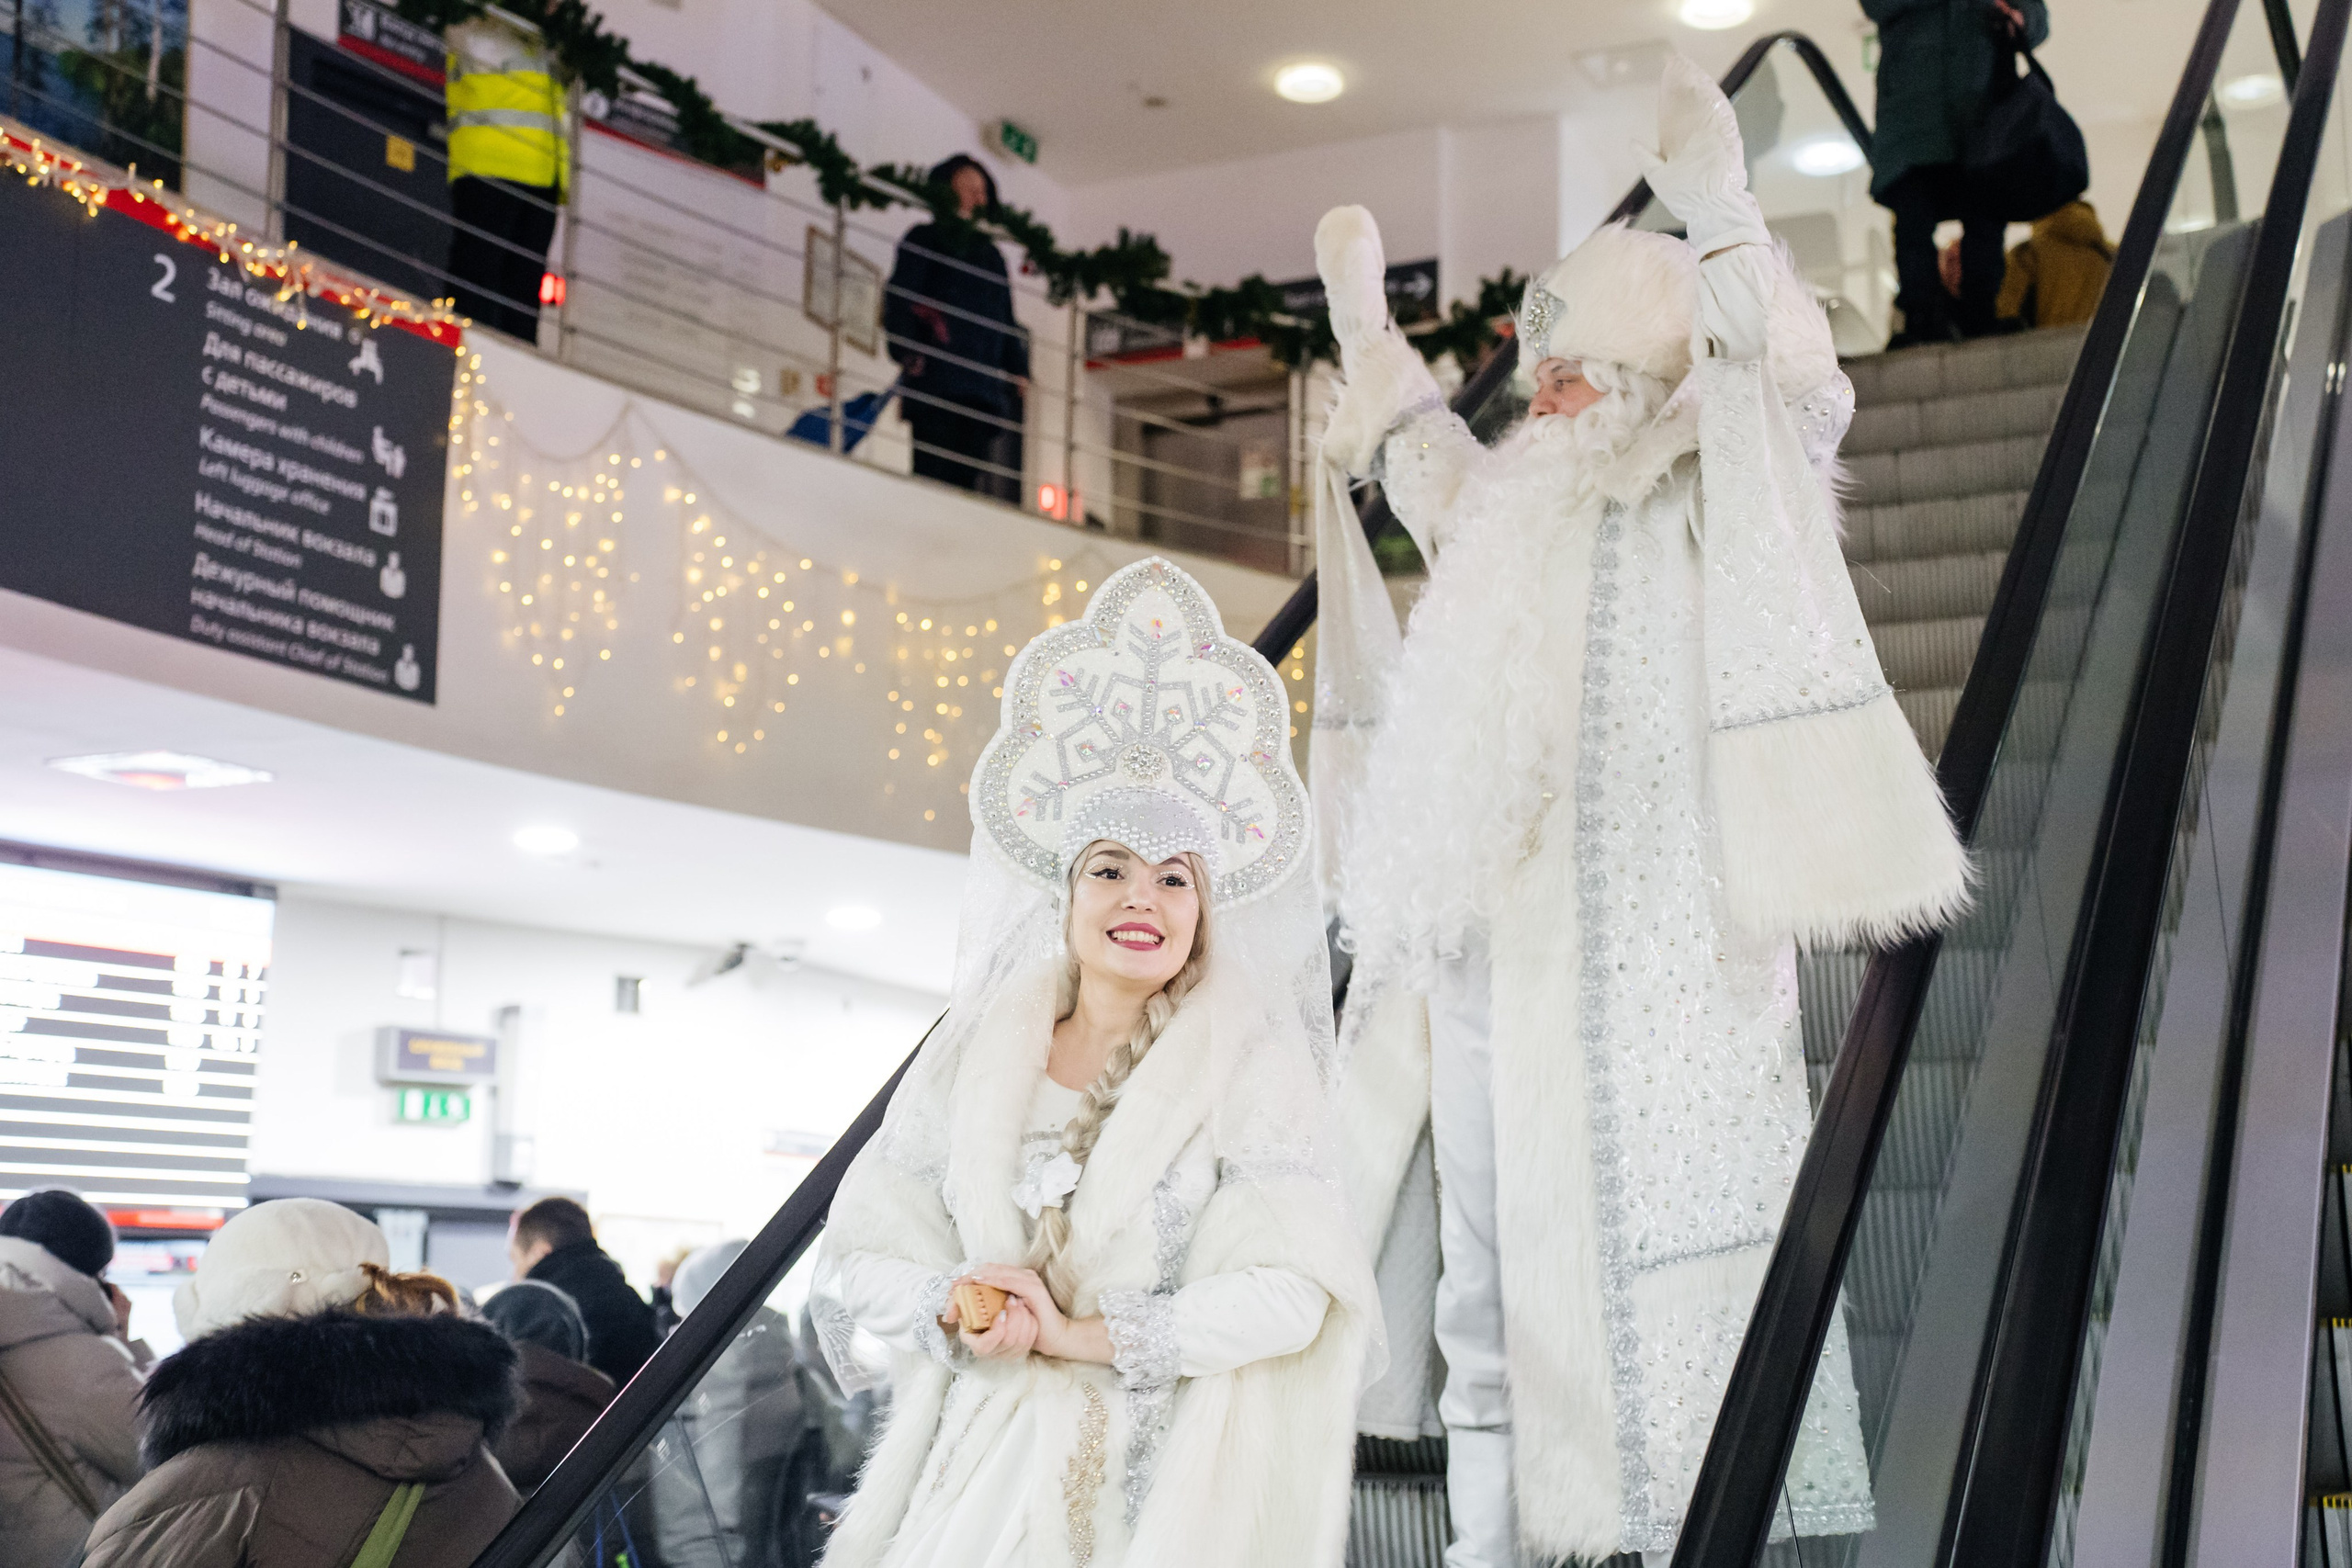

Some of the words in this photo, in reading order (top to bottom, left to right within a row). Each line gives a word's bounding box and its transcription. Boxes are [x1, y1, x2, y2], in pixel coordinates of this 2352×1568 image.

[151, 254, 176, 303] 2
[207, 266, 243, 300] Зал
[206, 300, 254, 336] Sitting
[201, 366, 214, 385] с
[214, 371, 288, 412] детьми
[202, 331, 242, 364] Для
[244, 350, 358, 409] пассажиров
[200, 392, 277, 434] Passengers
[277, 424, 310, 445] with
[198, 456, 229, 482] Left
[230, 467, 289, 502] luggage
[289, 489, 331, 515] office
[199, 425, 275, 471] Камера
[277, 457, 367, 502] хранения
[194, 521, 235, 548] Head
[233, 535, 254, 552] of
[253, 538, 303, 570] Station
[195, 490, 300, 545] Начальник
[301, 528, 377, 568] вокзала
[191, 551, 297, 603] Дежурный
[297, 587, 396, 633] помощник
[190, 587, 305, 635] начальника
[306, 619, 381, 657] вокзала
